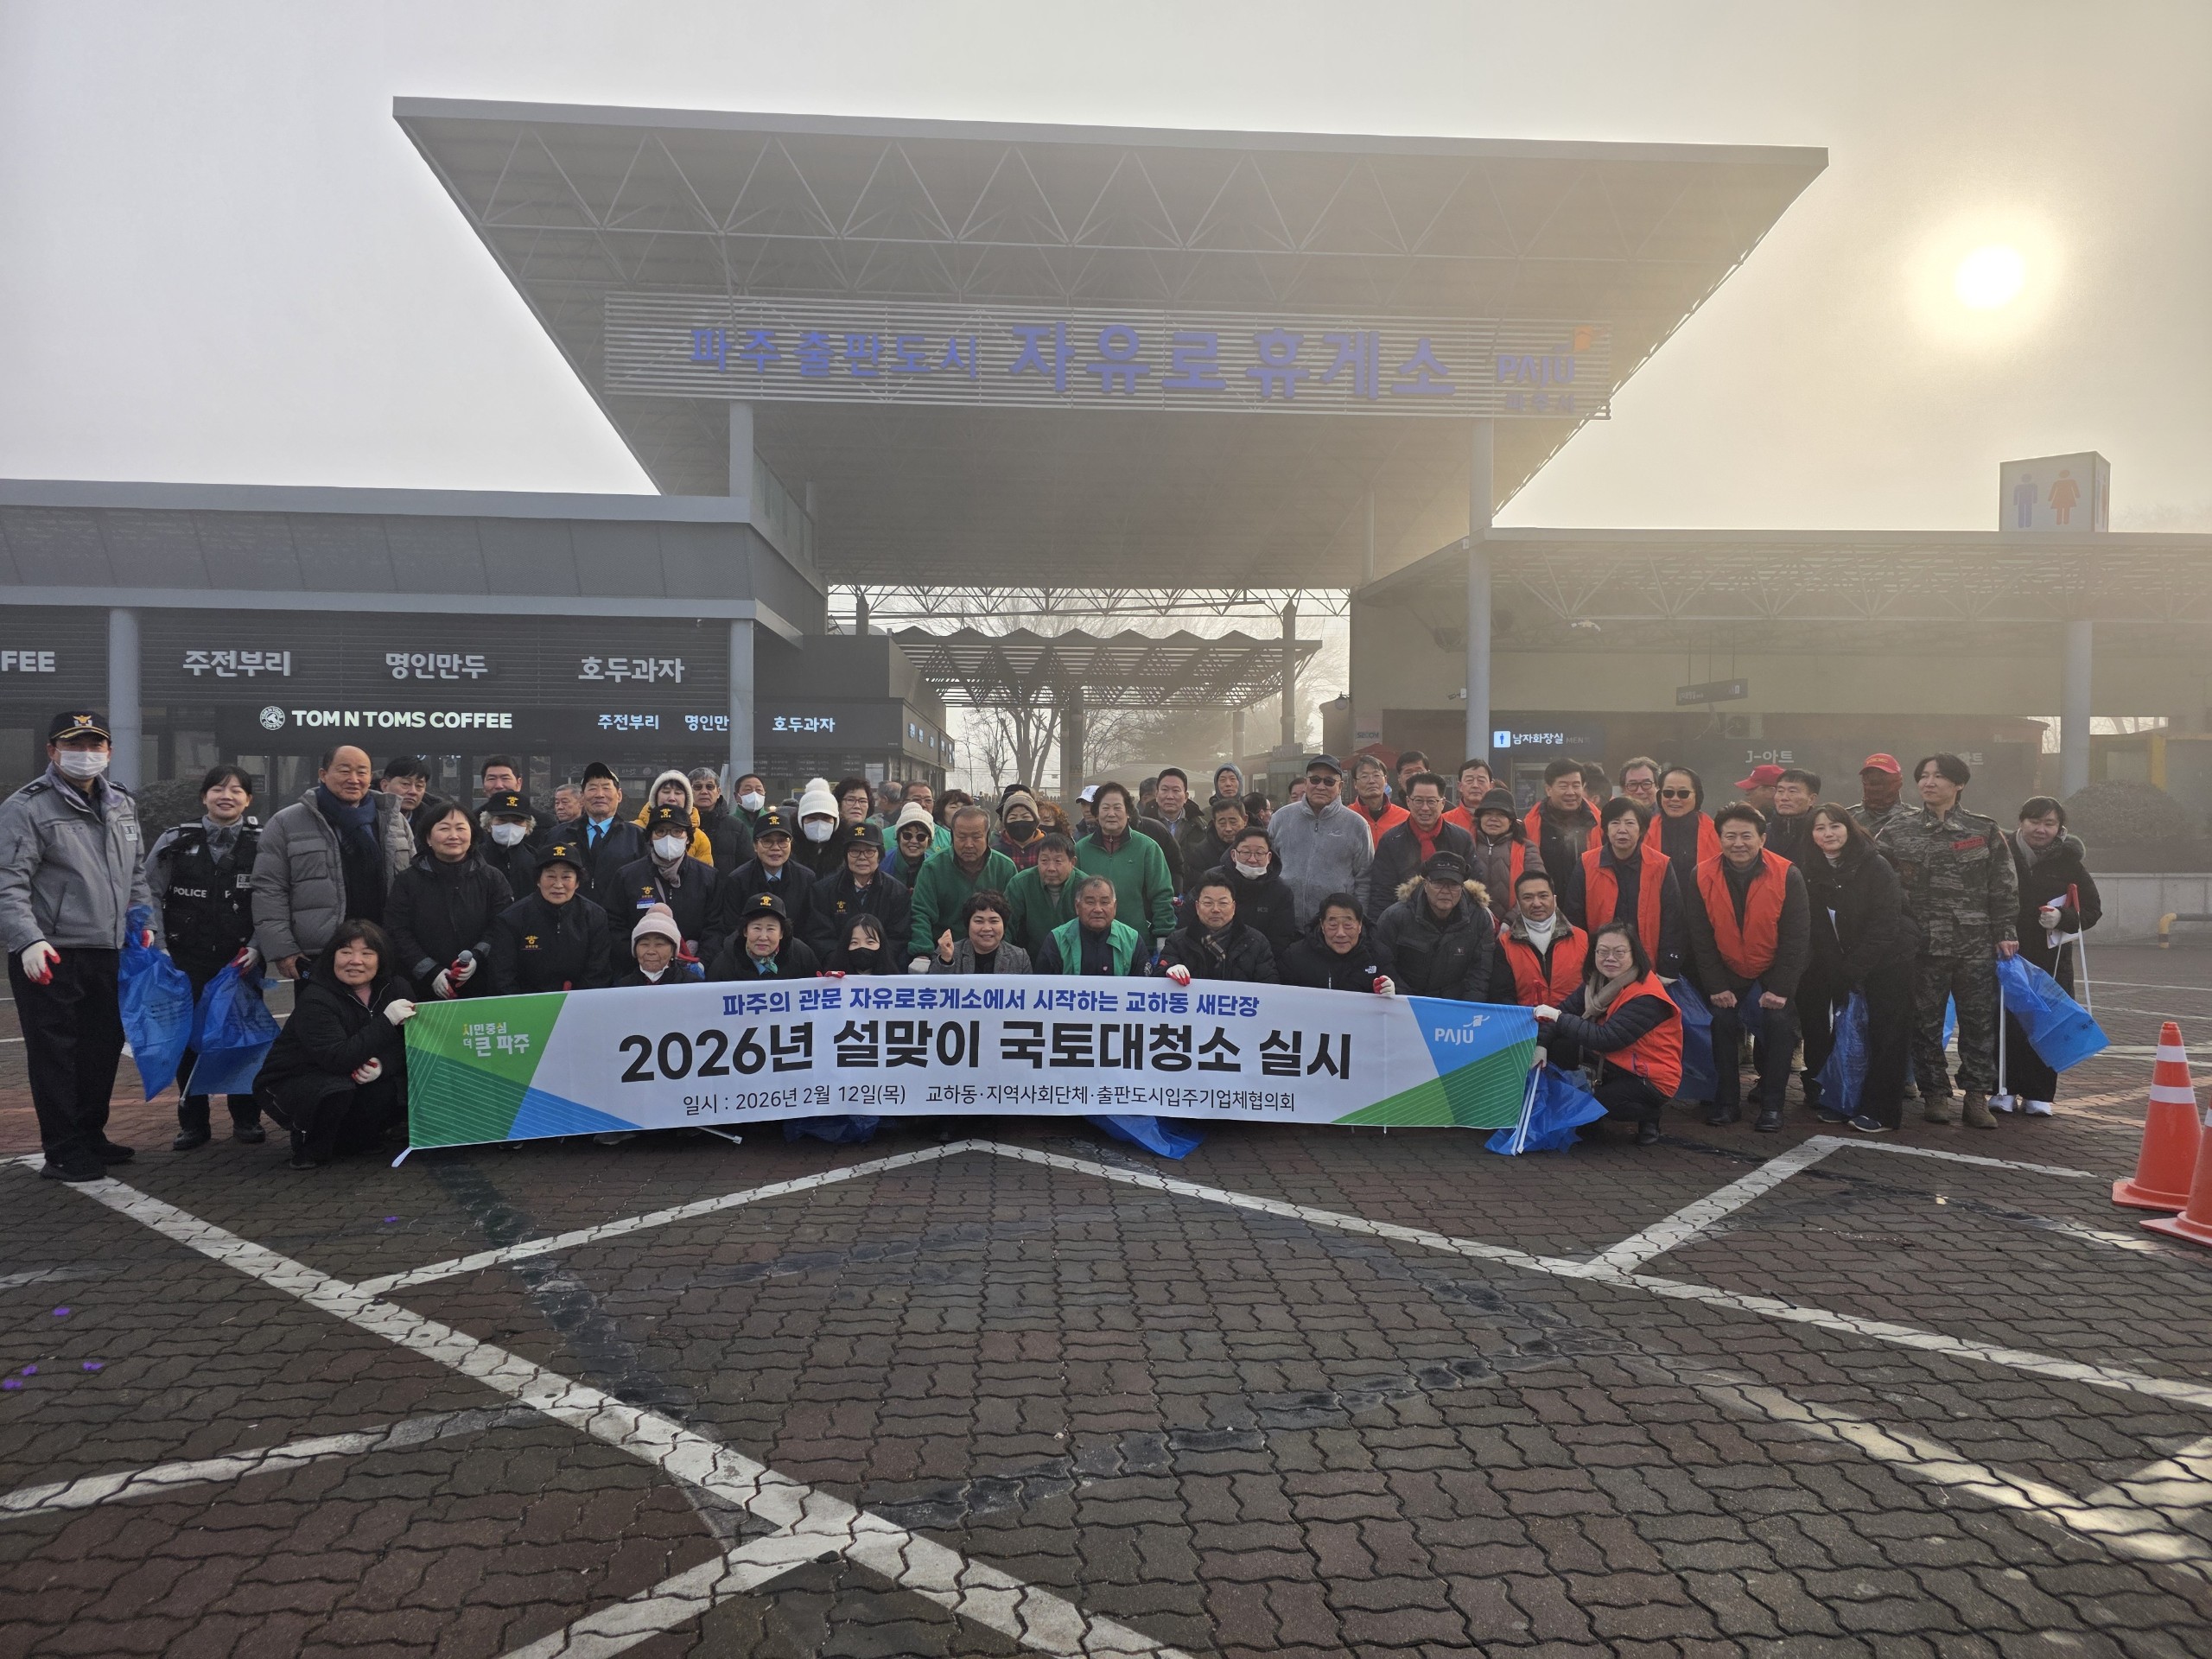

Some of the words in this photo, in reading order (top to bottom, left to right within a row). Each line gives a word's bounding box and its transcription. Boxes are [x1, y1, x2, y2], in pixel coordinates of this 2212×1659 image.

[1497, 354, 1575, 388] PAJU
[182, 650, 291, 677] 주전부리
[385, 652, 489, 680] 명인만두
[578, 656, 685, 683] 호두과자
[292, 709, 340, 727] TOM
[345, 710, 359, 727] N
[363, 711, 426, 728] TOMS
[429, 712, 512, 728] COFFEE
[597, 714, 659, 730] 주전부리
[772, 715, 836, 733] 호두과자
[1512, 732, 1564, 745] 남자화장실
[1745, 749, 1795, 765] J-아트
[174, 886, 207, 899] POLICE
[722, 991, 791, 1016] 파주의
[798, 988, 842, 1010] 관문
[849, 988, 1026, 1010] 자유로휴게소에서
[1033, 989, 1119, 1013] 시작하는
[1125, 991, 1189, 1014] 교하동
[1196, 994, 1260, 1018] 새단장
[462, 1021, 507, 1037] 시민중심
[1434, 1027, 1474, 1046] PAJU
[474, 1036, 492, 1058] 큰
[496, 1033, 531, 1055] 파주
[619, 1020, 813, 1084] 2026년
[833, 1020, 980, 1069] 설맞이
[1000, 1020, 1242, 1073] 국토대청소
[1259, 1029, 1351, 1080] 실시
[683, 1094, 718, 1116] 일시
[735, 1087, 798, 1110] 2026년
[803, 1084, 830, 1105] 2월
[837, 1084, 906, 1105] 12일(목)
